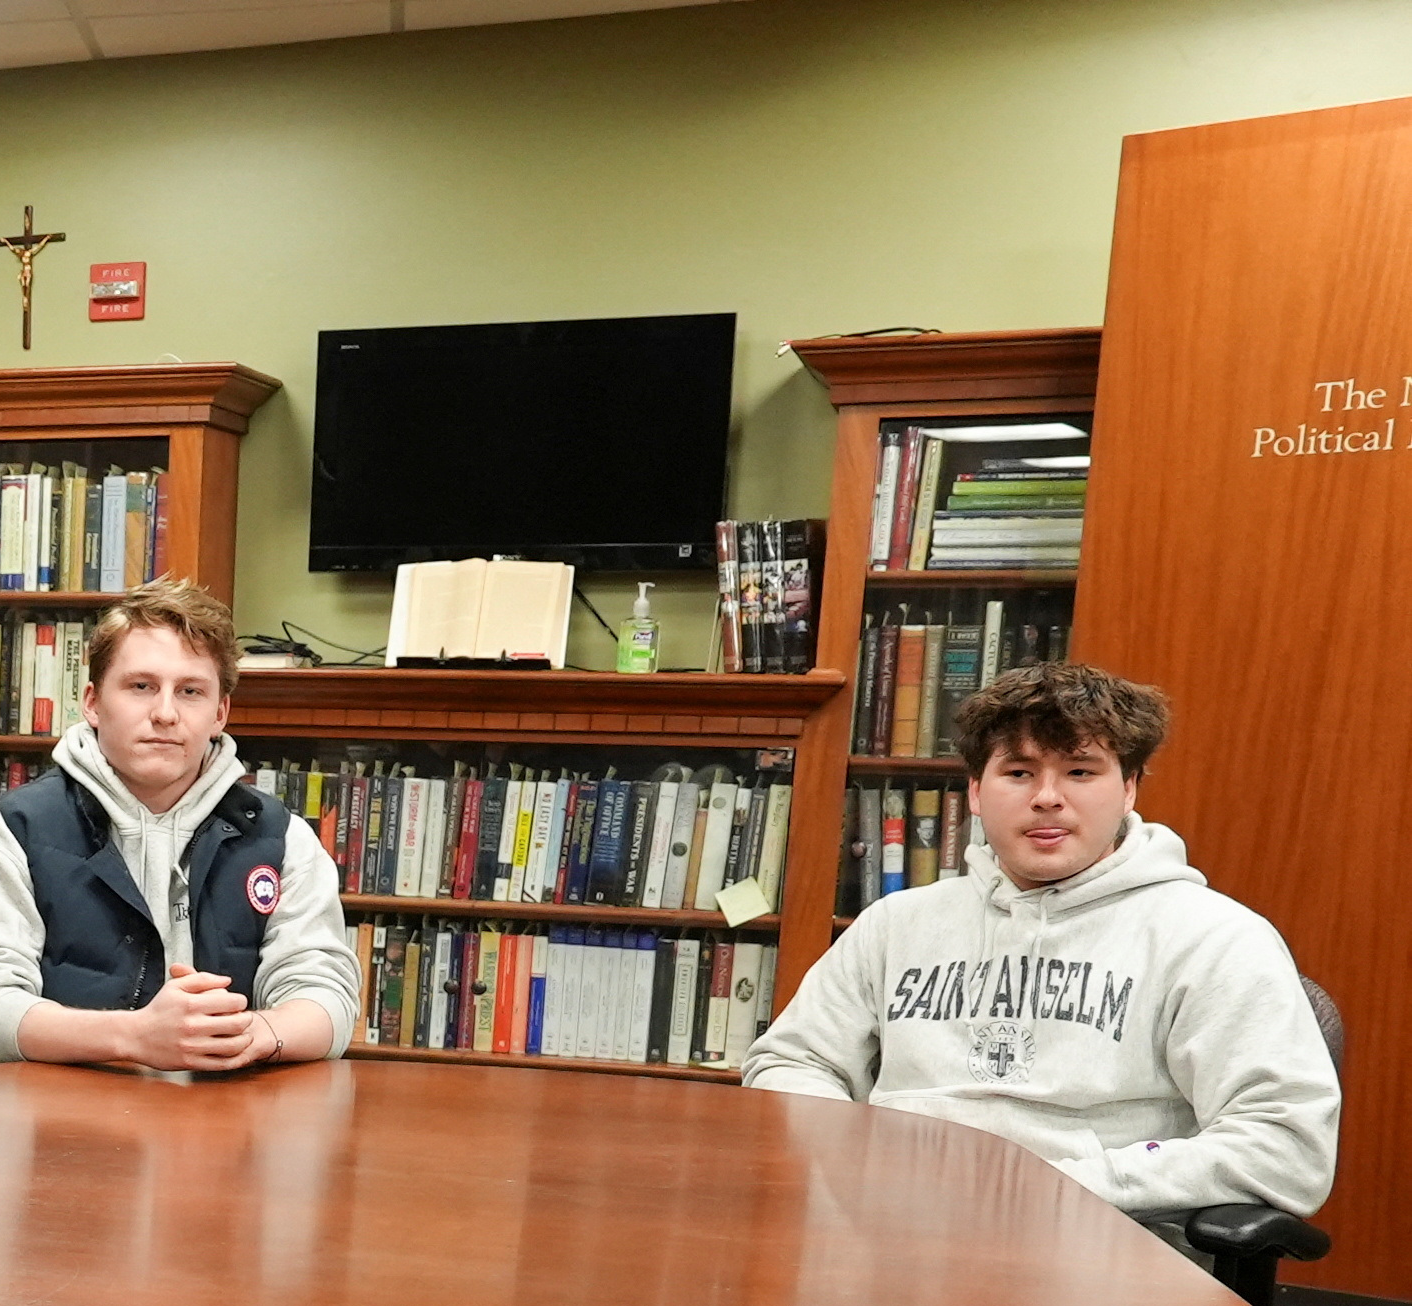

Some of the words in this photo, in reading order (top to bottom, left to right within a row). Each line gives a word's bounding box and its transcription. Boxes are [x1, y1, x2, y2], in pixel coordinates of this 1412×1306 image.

[102, 268, 131, 279] FIRE
[101, 304, 130, 314] FIRE
[1314, 377, 1388, 413] The
[1250, 418, 1397, 459] Political
[988, 633, 998, 666] CACTUS
[606, 792, 614, 803] OF
[949, 799, 958, 822] ROSE
[541, 806, 551, 823] EASY
[599, 805, 612, 836] OFFICE
[611, 792, 626, 839] COMMAND
[631, 797, 648, 860] PRESIDENTS
[538, 826, 548, 840] DAY
[945, 824, 956, 867] KENNEDY
[625, 869, 636, 893] WAR
[888, 957, 992, 1022] SAINT
[989, 955, 1133, 1043] ANSELM
